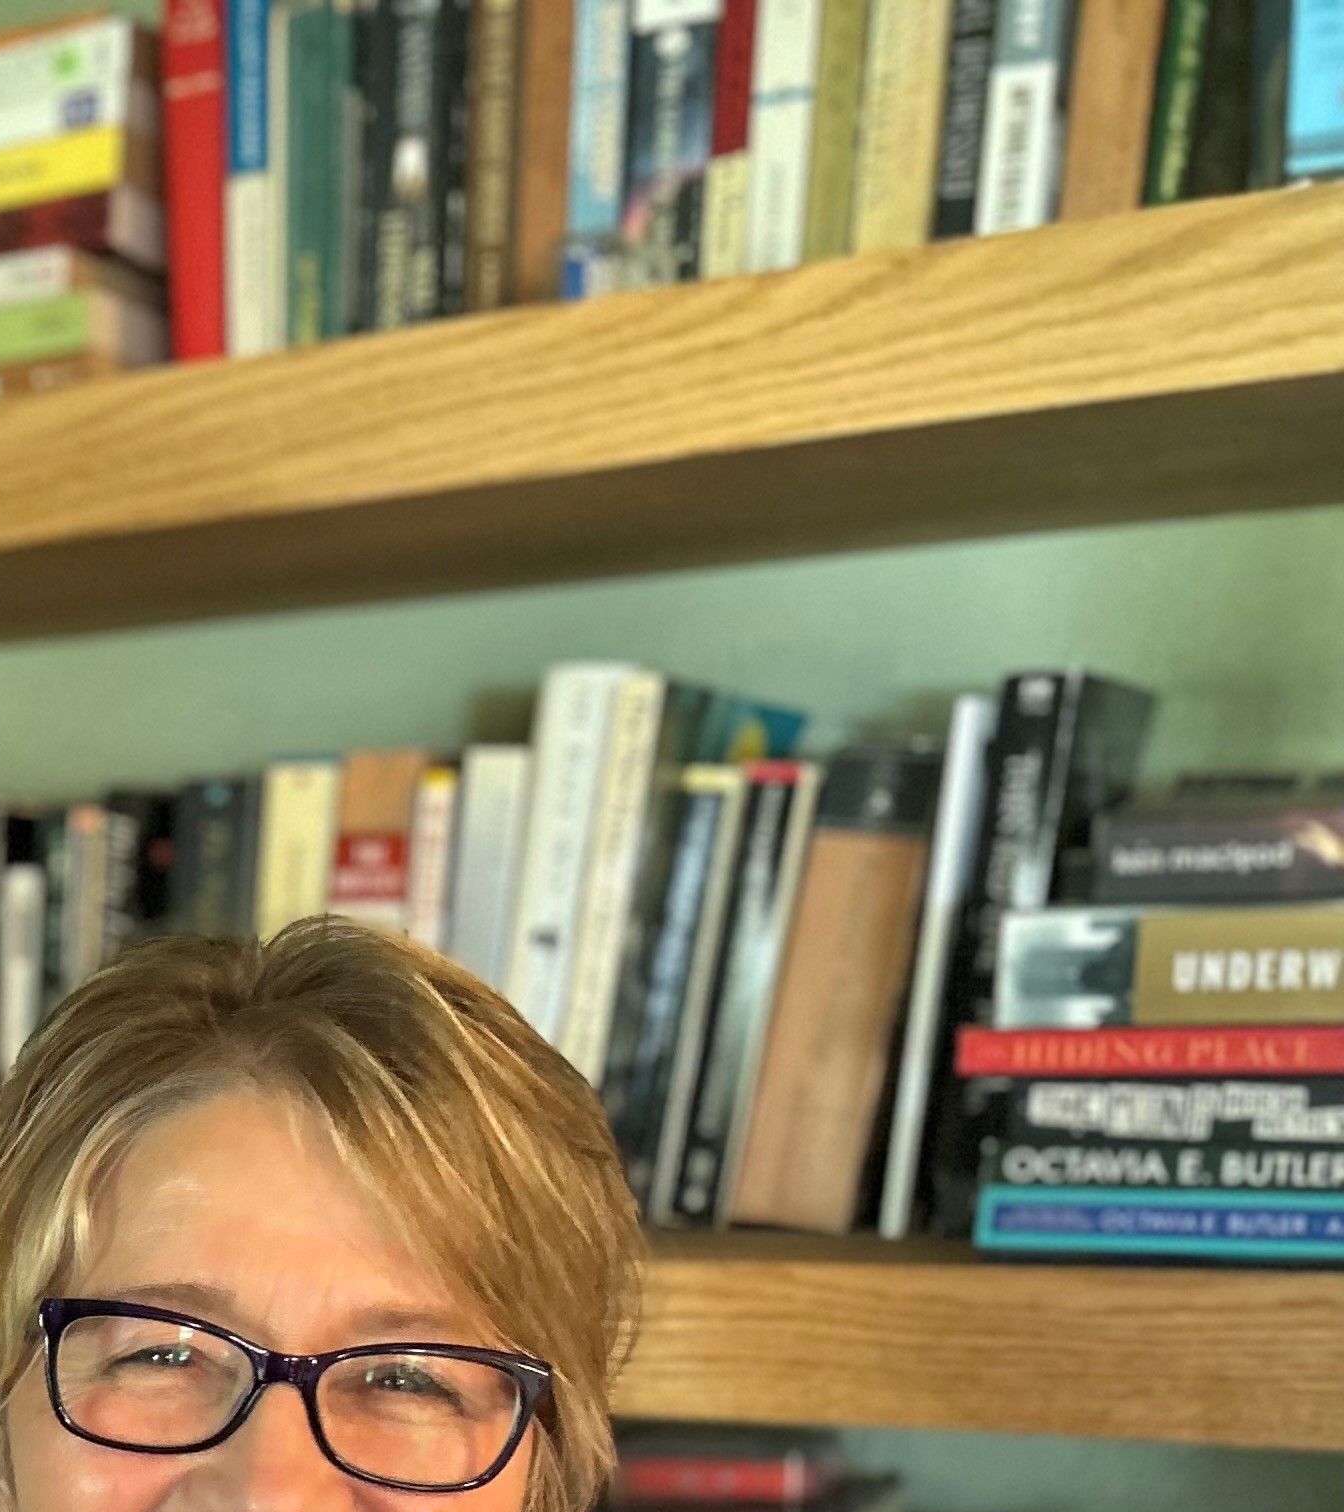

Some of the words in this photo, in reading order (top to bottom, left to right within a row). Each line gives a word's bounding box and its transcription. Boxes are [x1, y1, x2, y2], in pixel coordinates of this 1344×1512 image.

[1172, 947, 1344, 995] UNDERW
[1002, 1144, 1170, 1186] OCTAVIA
[1176, 1146, 1213, 1186] E.
